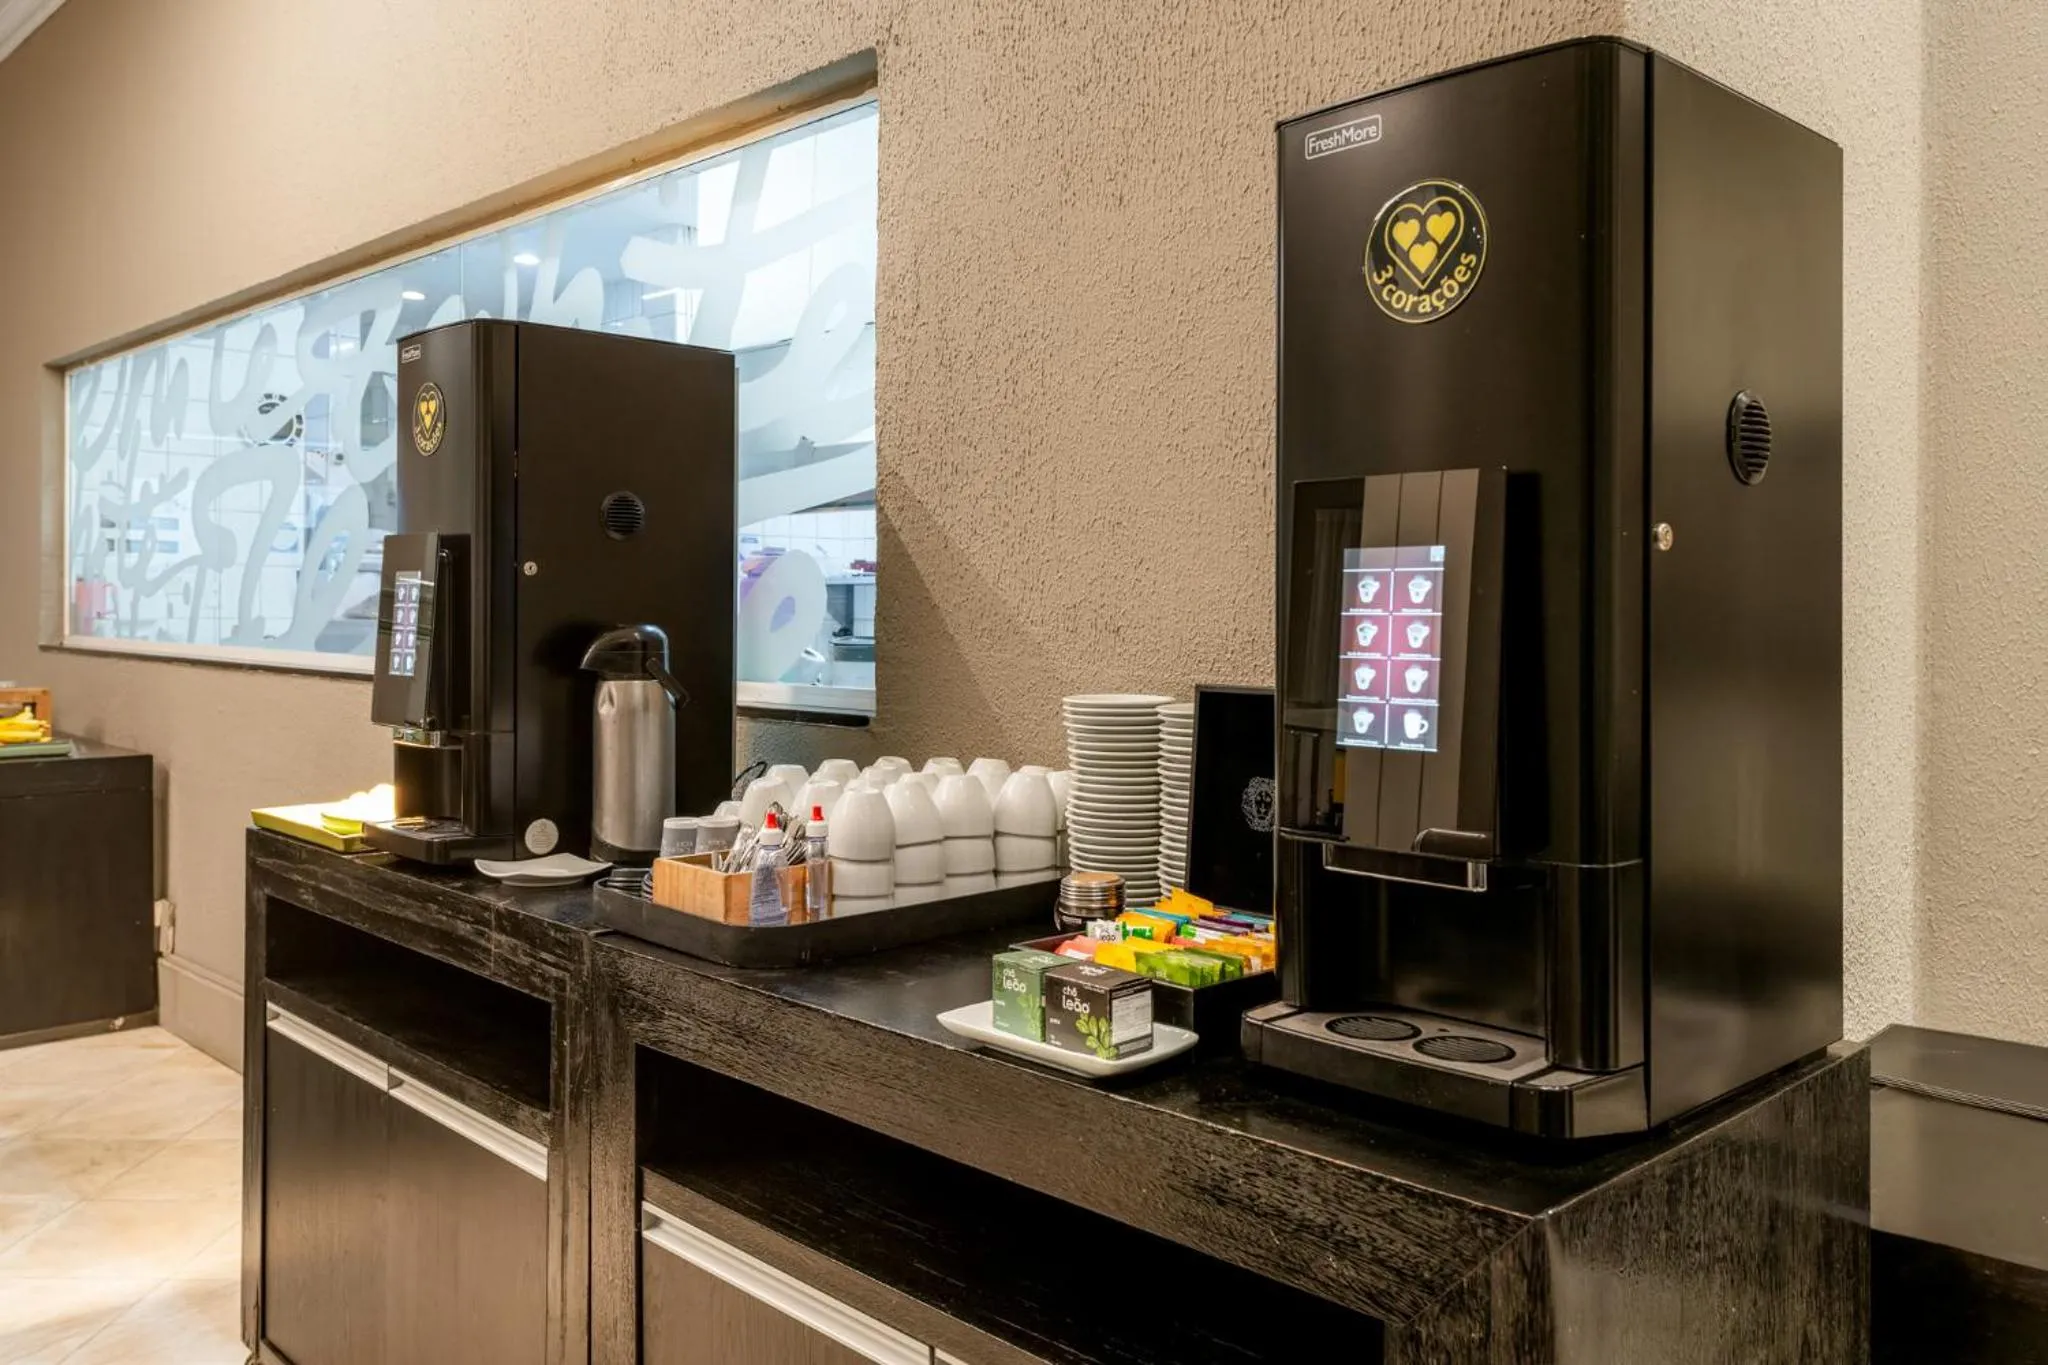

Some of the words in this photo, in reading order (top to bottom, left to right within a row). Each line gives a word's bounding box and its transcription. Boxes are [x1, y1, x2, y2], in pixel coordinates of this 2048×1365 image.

[1308, 124, 1378, 154] FreshMore
[1372, 264, 1394, 285] 3
[1381, 251, 1477, 314] corações
[1003, 976, 1026, 993] leão
[1062, 995, 1089, 1014] leão
